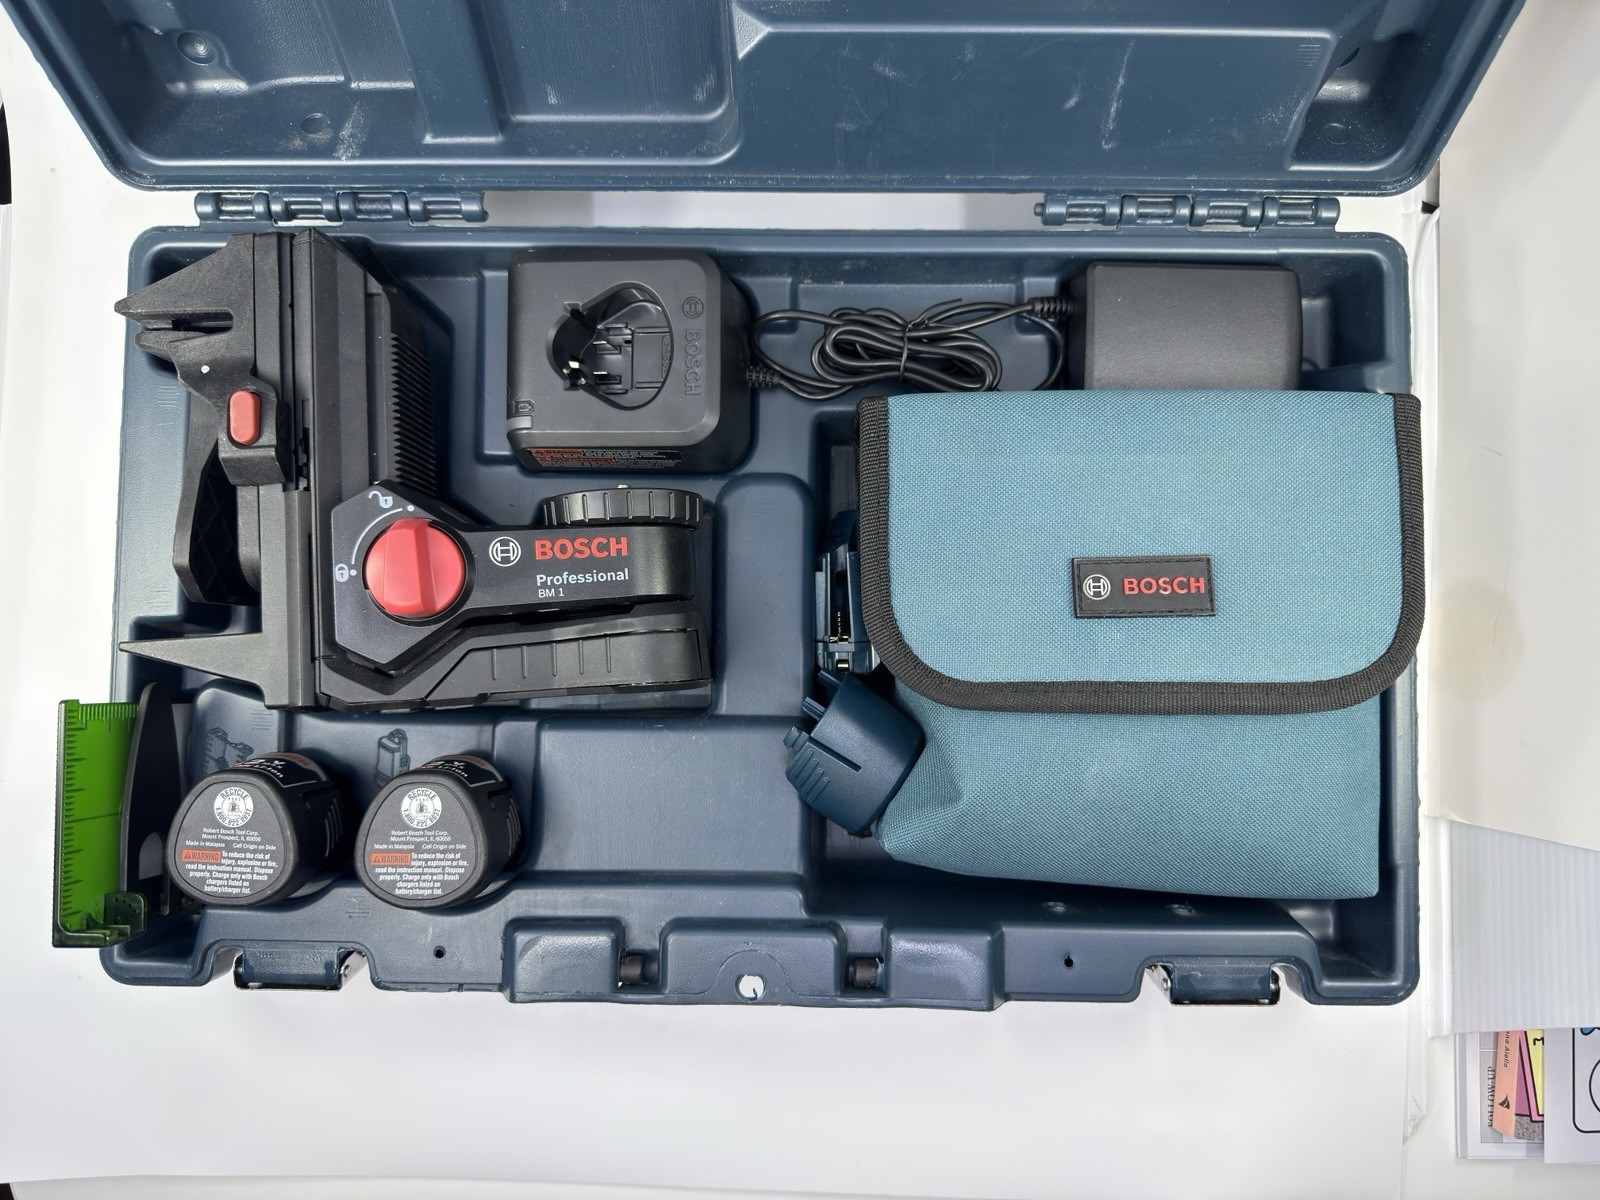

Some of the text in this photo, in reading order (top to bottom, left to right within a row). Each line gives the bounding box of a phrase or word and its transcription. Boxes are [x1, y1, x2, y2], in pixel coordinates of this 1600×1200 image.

[685, 329, 701, 396] BOSCH
[535, 536, 628, 560] BOSCH
[536, 568, 629, 586] Professional
[1123, 576, 1206, 595] BOSCH
[538, 588, 564, 598] BM 1
[220, 788, 249, 800] RECYCLE
[407, 789, 437, 800] RECYCLE
[191, 851, 220, 861] WARNING
[380, 854, 409, 863] WARNING
[221, 858, 236, 866] injury,
[268, 860, 278, 868] fire,
[411, 859, 426, 867] injury,
[212, 871, 229, 879] Charge
[207, 878, 227, 886] chargers
[205, 885, 241, 894] battery/charger
[395, 888, 433, 896] battery/charger
